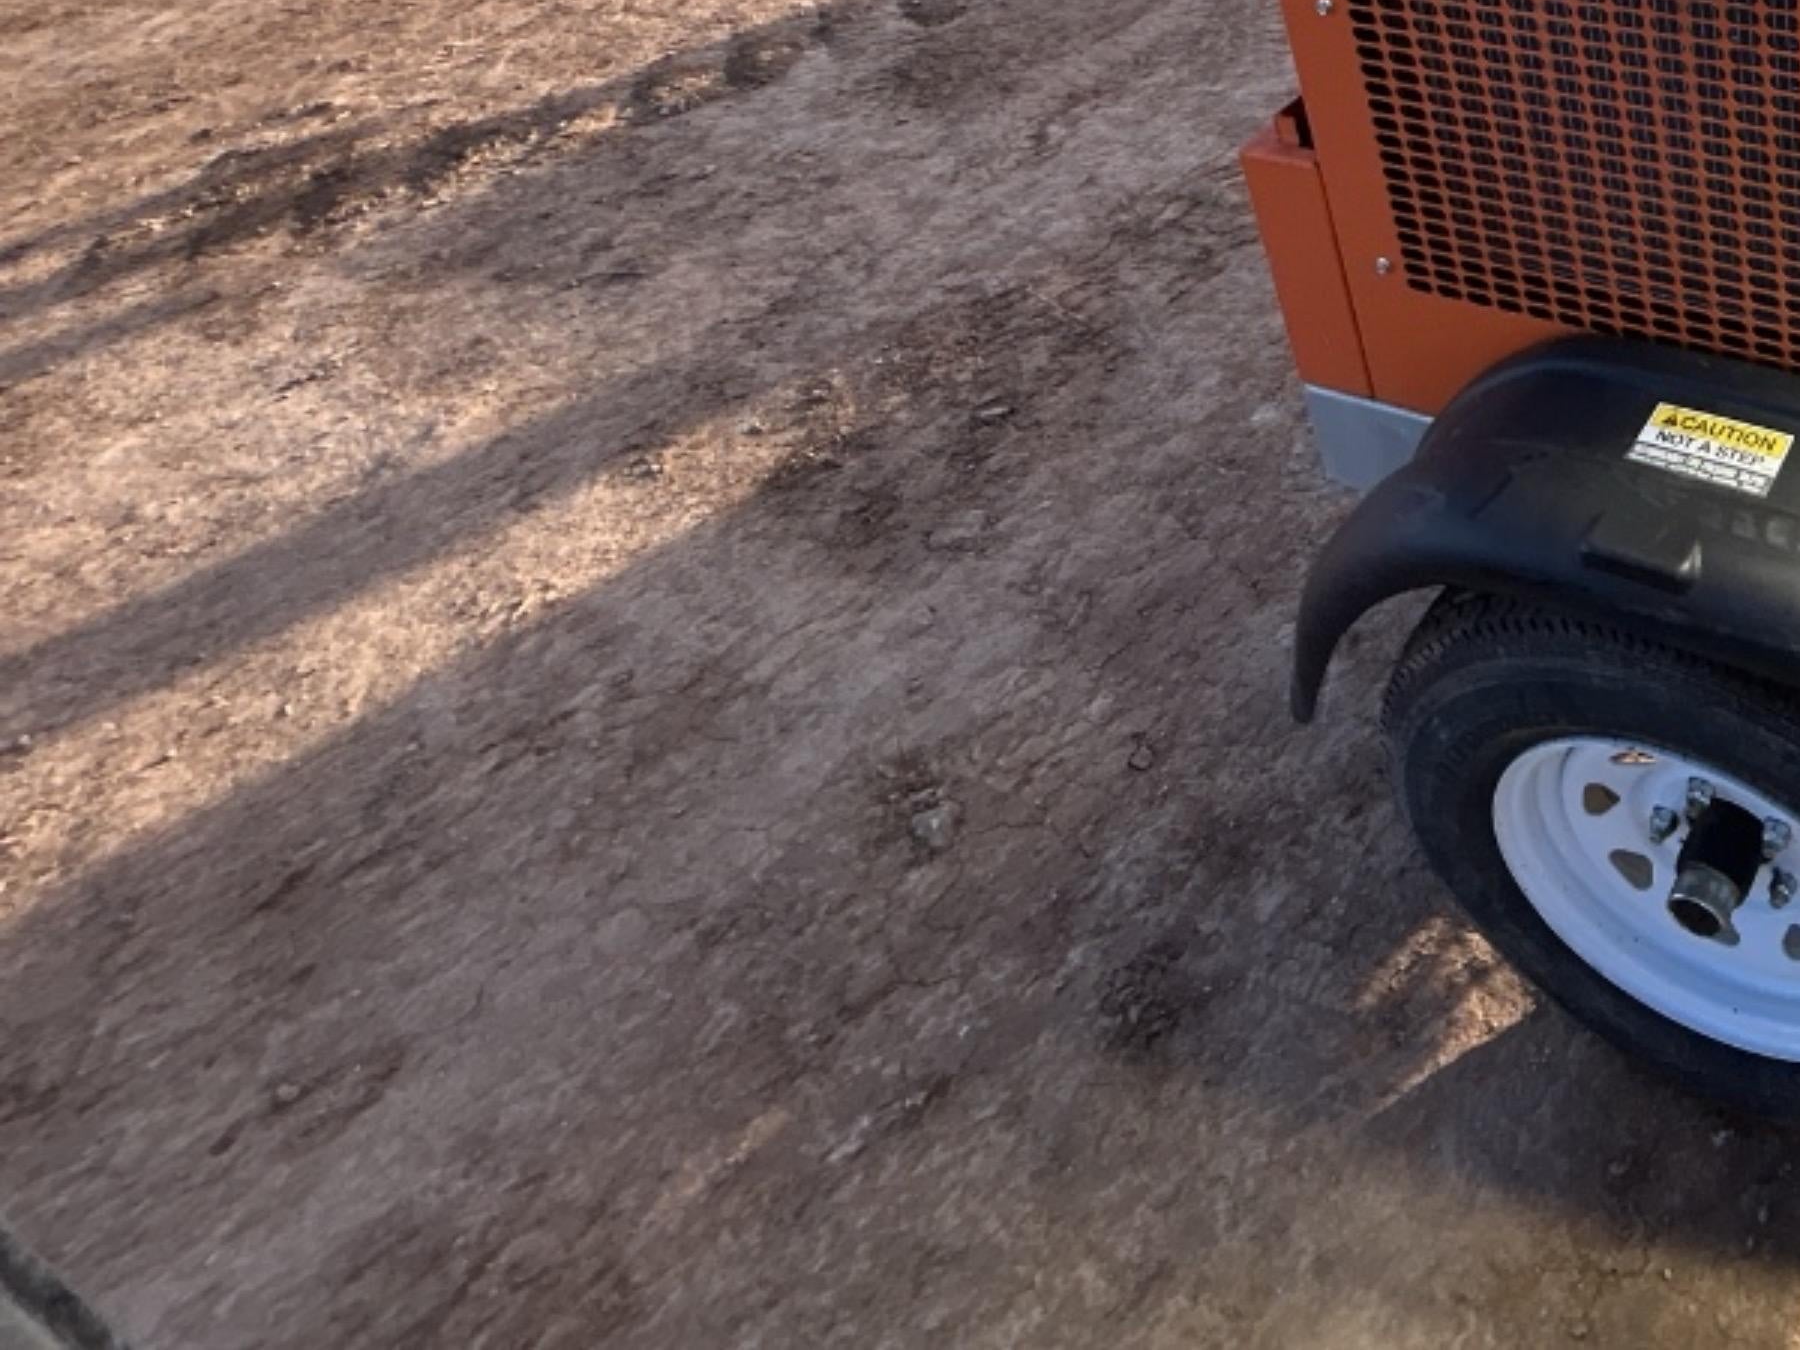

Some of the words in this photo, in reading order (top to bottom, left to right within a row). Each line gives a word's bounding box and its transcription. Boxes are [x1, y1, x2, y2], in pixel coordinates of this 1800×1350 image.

[1655, 430, 1692, 449] NOT
[1698, 440, 1711, 453] A
[1715, 446, 1766, 466] STEP
[1679, 416, 1778, 451] CAUTION
